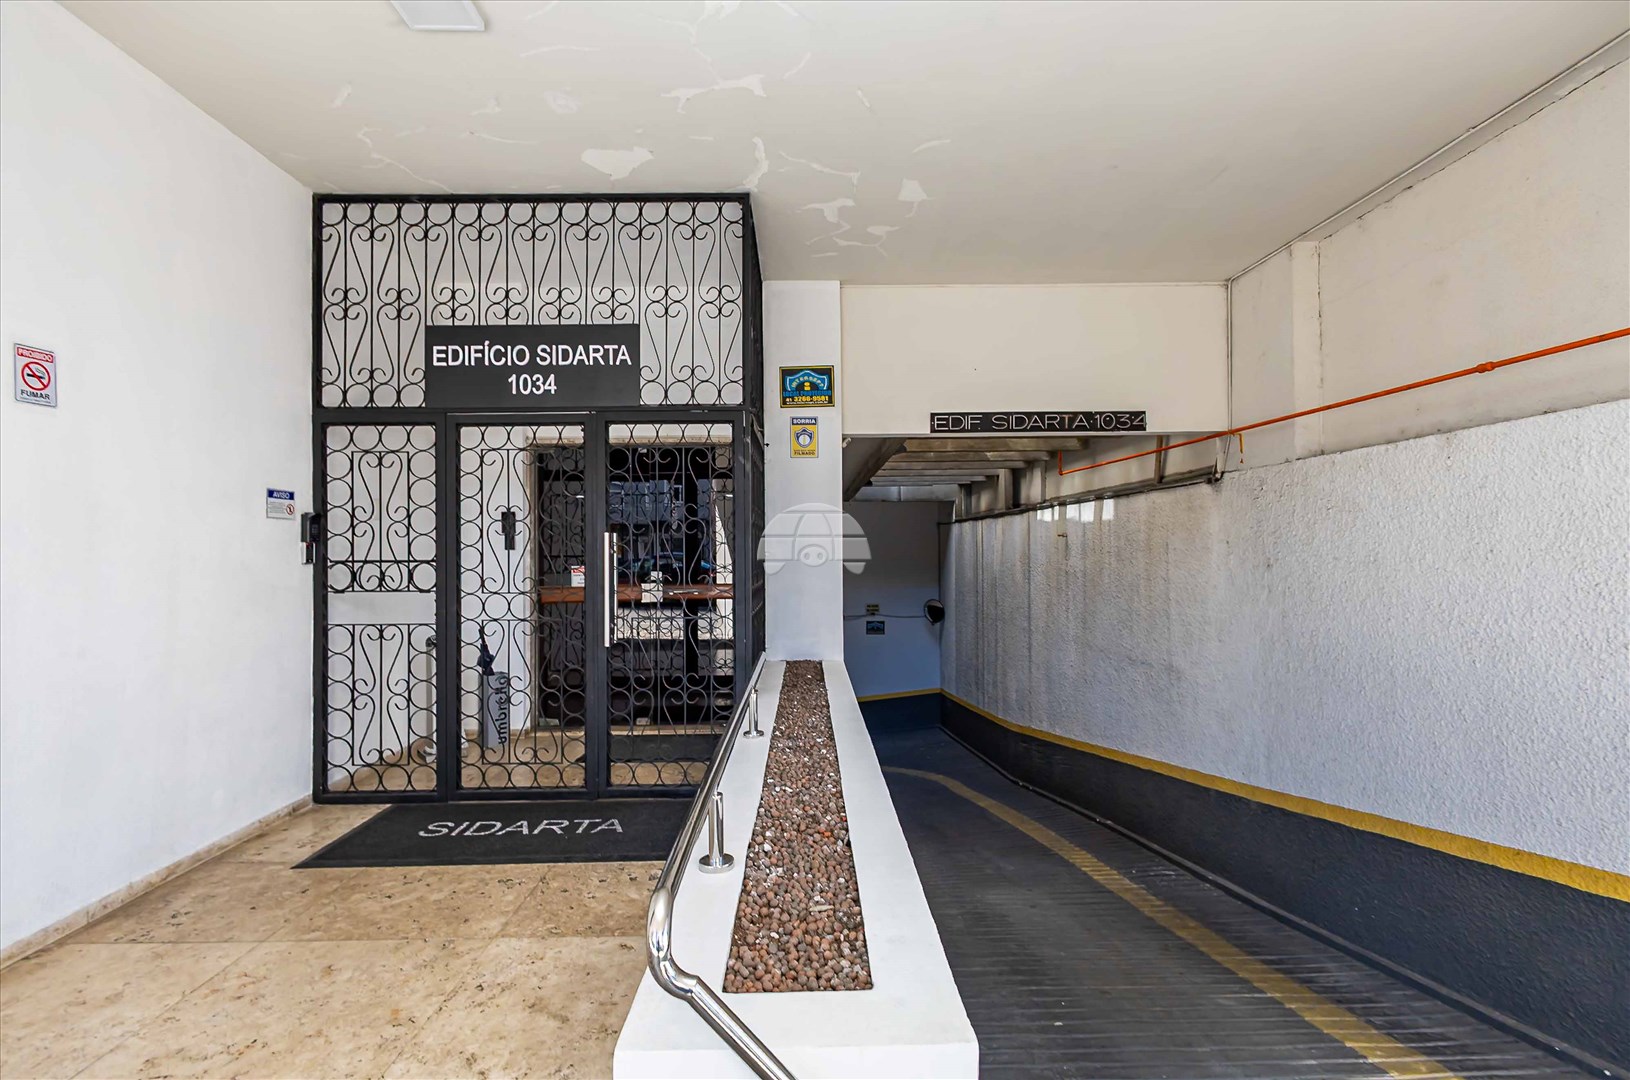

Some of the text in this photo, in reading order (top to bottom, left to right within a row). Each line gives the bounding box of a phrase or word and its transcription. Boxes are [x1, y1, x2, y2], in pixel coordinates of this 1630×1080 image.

[432, 340, 632, 366] EDIFÍCIO SIDARTA
[508, 373, 557, 395] 1034
[20, 389, 50, 400] FUMAR
[991, 414, 1090, 430] SIDARTA
[272, 491, 290, 499] AVISO
[417, 818, 624, 837] SIDARTA
